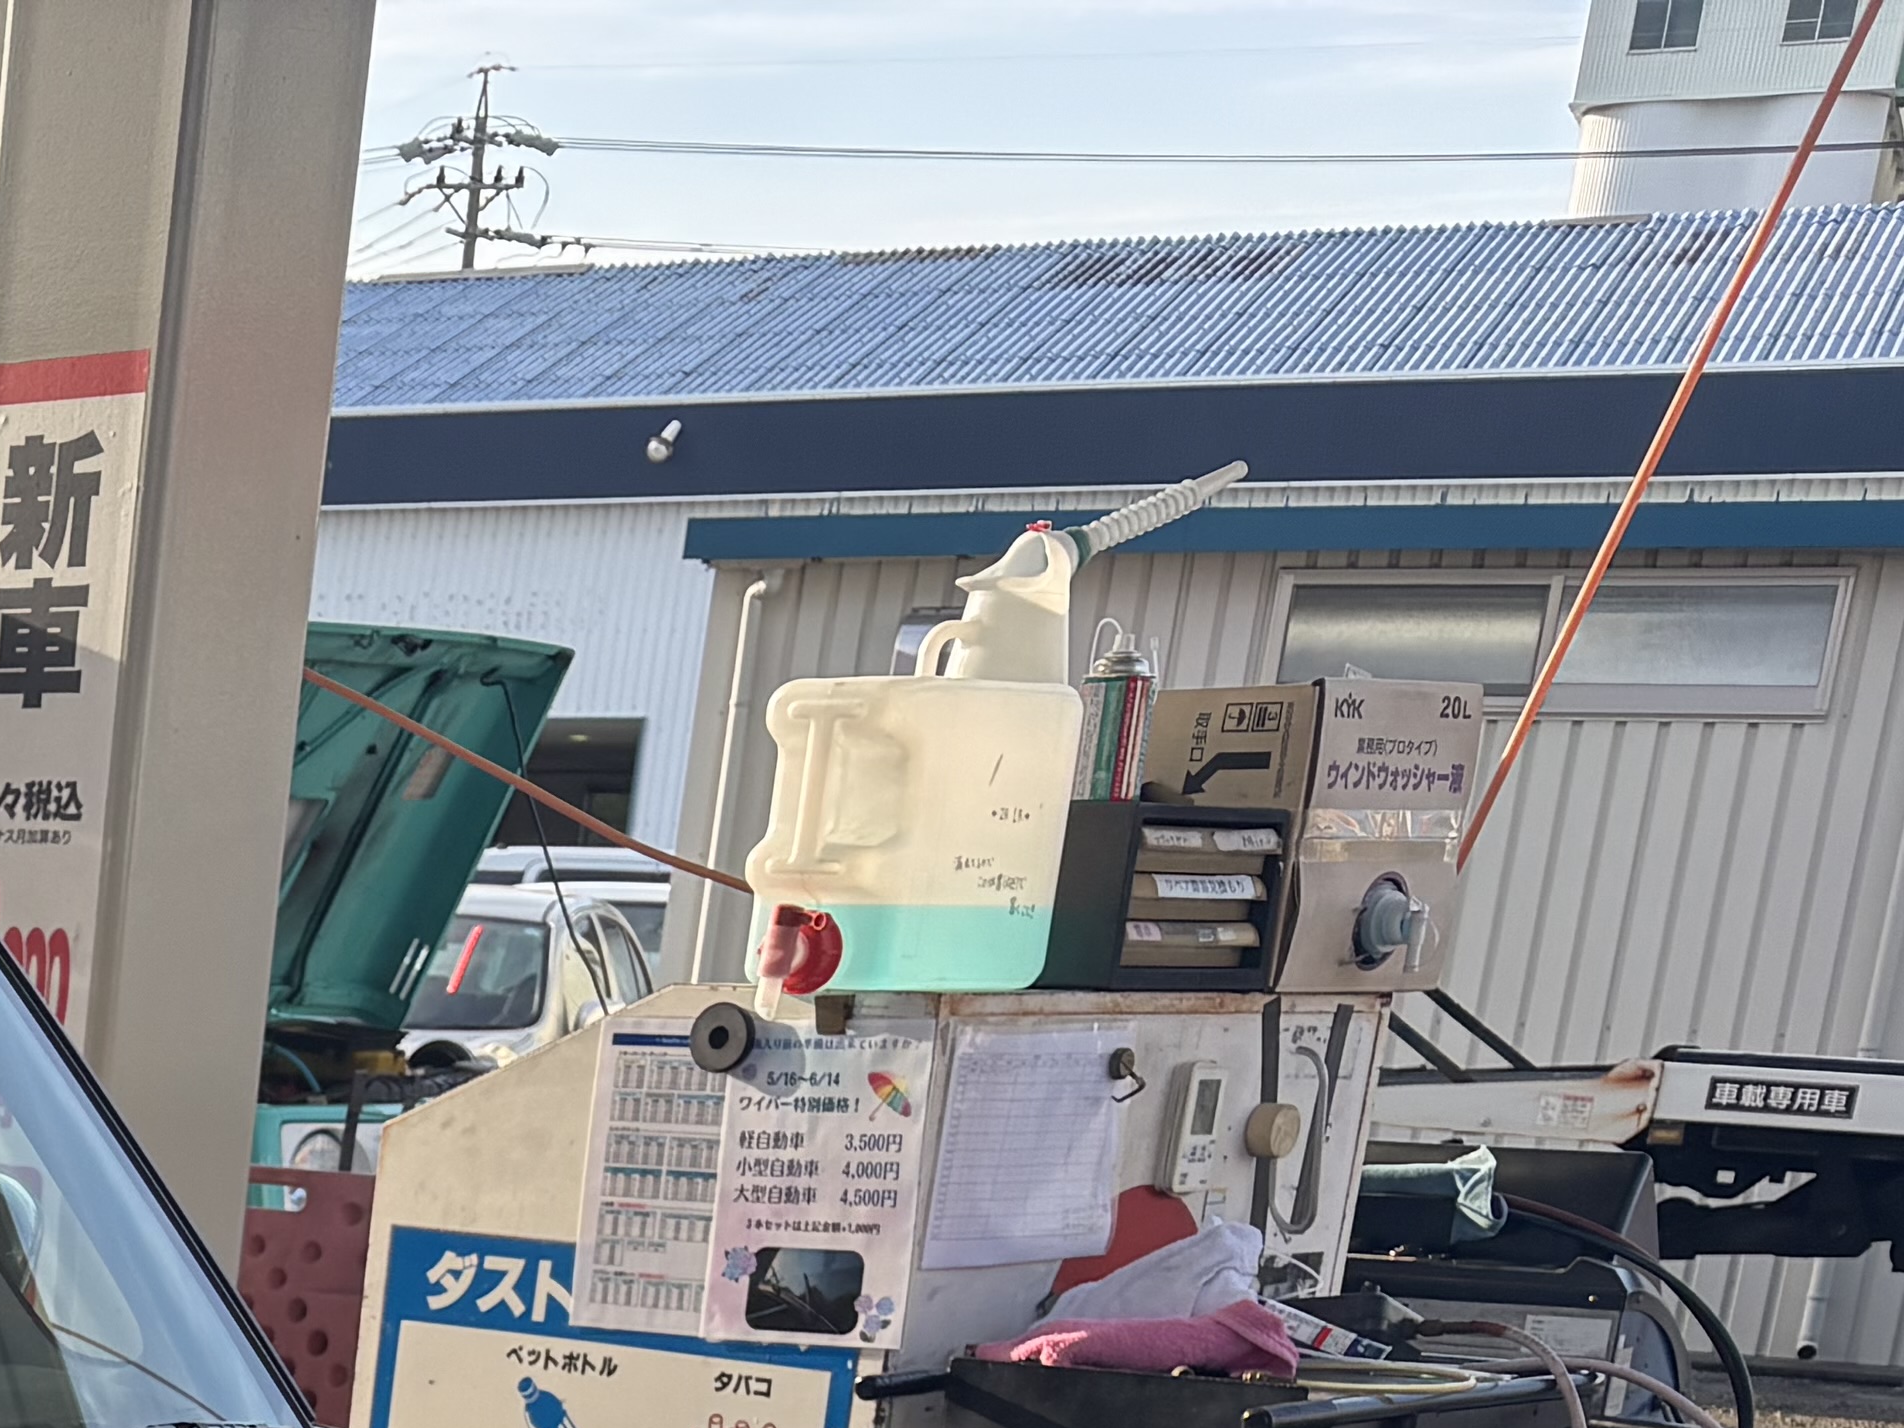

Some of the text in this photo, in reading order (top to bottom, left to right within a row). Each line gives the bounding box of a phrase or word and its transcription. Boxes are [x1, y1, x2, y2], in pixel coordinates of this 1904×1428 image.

[1334, 692, 1472, 720] KYK 20L
[1711, 1081, 1850, 1114] 車載専用車
[738, 1130, 904, 1153] 軽自動車 3,500円
[735, 1157, 901, 1181] 小型自動車 4,000円
[732, 1185, 898, 1208] 大型自動車 4,500円
[505, 1346, 619, 1378] ペットボトル
[713, 1372, 774, 1398] タバコ
